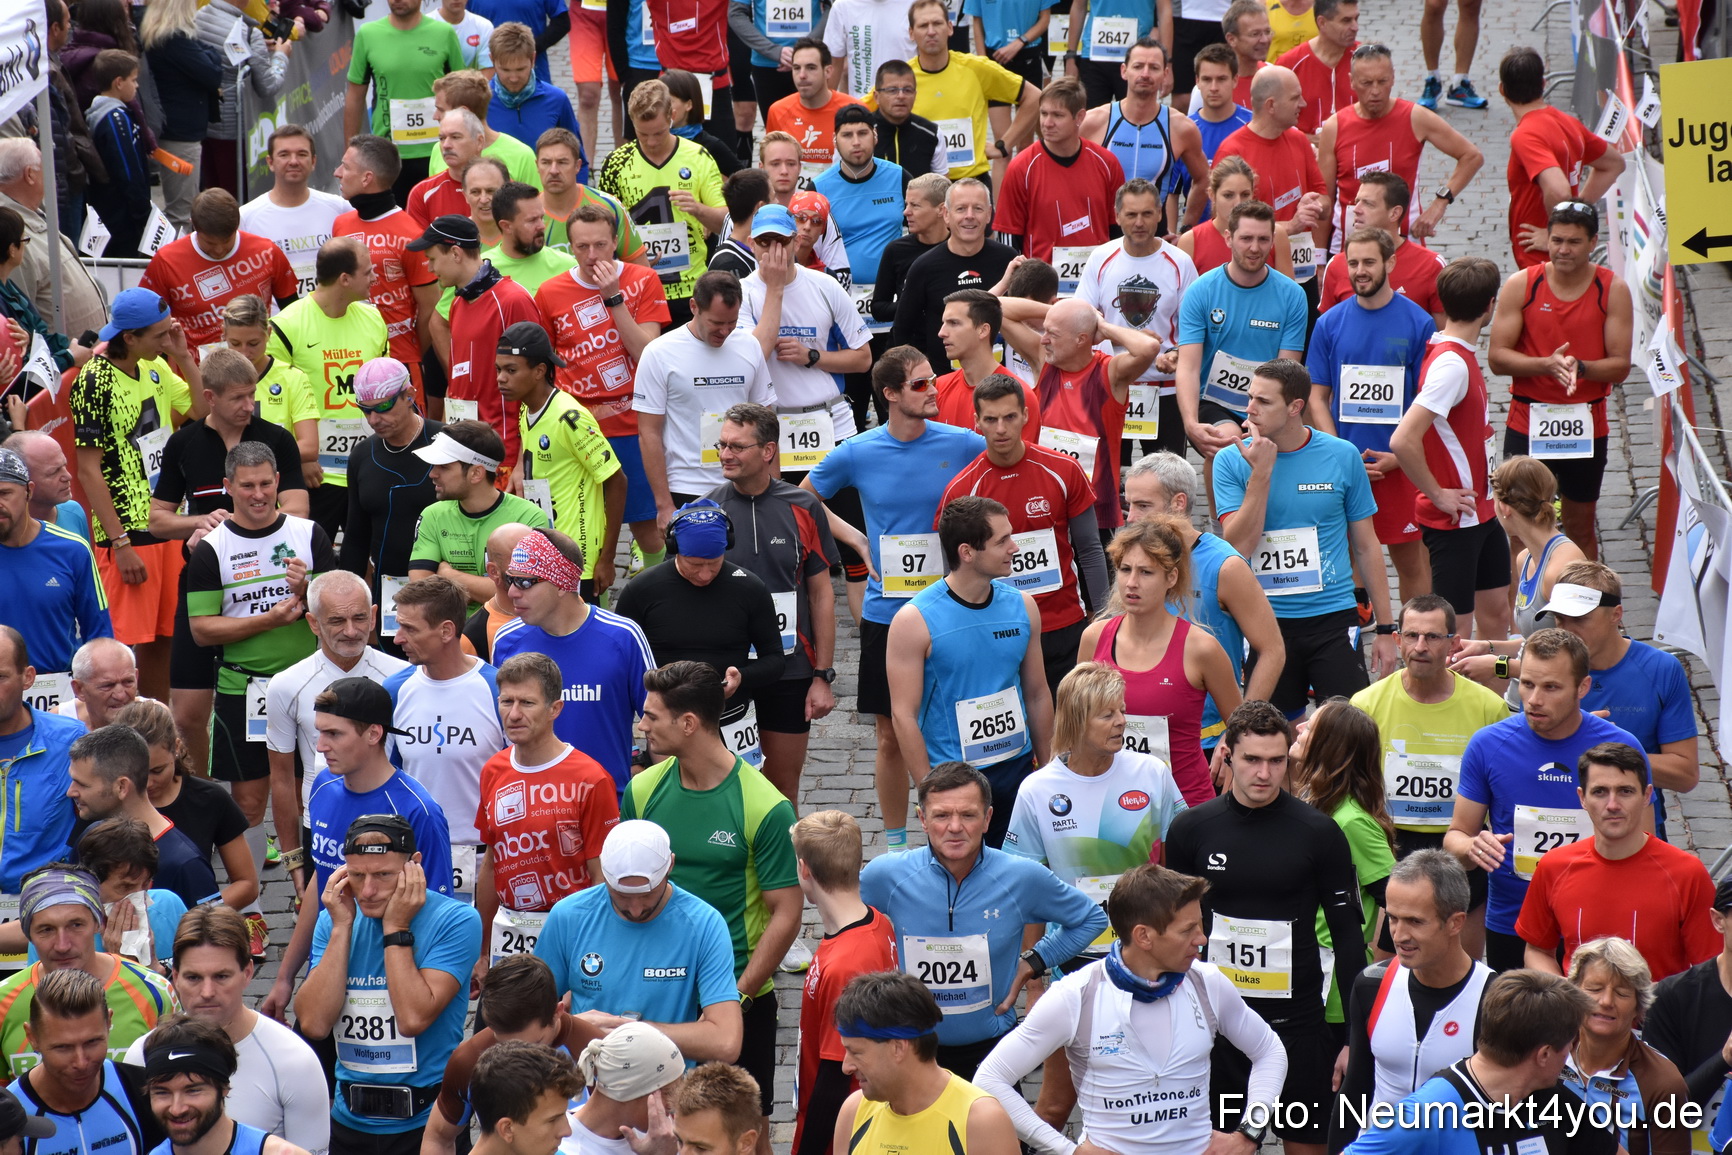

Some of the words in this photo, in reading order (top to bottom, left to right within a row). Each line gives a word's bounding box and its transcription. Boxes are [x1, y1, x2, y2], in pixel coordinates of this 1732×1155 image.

[773, 7, 804, 20] 2164
[1098, 31, 1130, 44] 2647
[406, 113, 425, 127] 55
[1668, 118, 1732, 153] Jug
[801, 153, 834, 161] neumark
[872, 196, 895, 206] THULE
[643, 238, 682, 256] 2673
[296, 277, 319, 295] 75
[957, 277, 983, 286] skinfit
[855, 299, 873, 315] 26
[1250, 318, 1280, 329] BOCK
[322, 348, 362, 362] Müller
[1655, 348, 1666, 373] wn
[1216, 369, 1251, 391] 292
[1349, 382, 1394, 402] 2280
[1358, 406, 1384, 416] Andreas
[1539, 419, 1584, 438] 2098
[787, 431, 821, 449] 149
[1545, 442, 1578, 451] Ferdinand
[149, 450, 165, 472] 26
[793, 454, 817, 463] Markus
[1298, 483, 1333, 491] BOCK
[902, 553, 927, 573] 97
[1011, 549, 1049, 574] 584
[1259, 547, 1309, 572] 2154
[233, 570, 262, 581] OBI
[1013, 575, 1042, 587] Thomas
[1272, 575, 1299, 586] Markus
[904, 578, 927, 588] Martin
[231, 586, 293, 605] Lauftea
[993, 628, 1021, 640] THULE
[968, 710, 1017, 741] 2655
[404, 722, 478, 750] SUSPA
[983, 739, 1012, 755] Matthias
[1414, 761, 1443, 770] BOCK
[1538, 774, 1573, 785] skinfit
[497, 784, 524, 799] raumbox
[1395, 775, 1453, 799] 2058
[1122, 794, 1147, 807] Hervis
[531, 808, 573, 819] schenken
[1405, 804, 1443, 814] Jezussek
[1051, 818, 1078, 829] PARTL
[1546, 816, 1577, 824] BOCK
[1053, 825, 1079, 834] Neumarkt
[708, 830, 737, 845] AOK
[1005, 831, 1019, 842] CK
[1207, 864, 1226, 872] Sondico
[1237, 927, 1267, 937] BOCK
[934, 944, 963, 952] BOCK
[1227, 942, 1267, 968] 151
[643, 967, 687, 979] BOCK
[917, 959, 978, 986] 2024
[1235, 973, 1261, 985] Lukas
[356, 997, 387, 1006] BOCK
[932, 991, 967, 1002] Michael
[341, 1014, 397, 1041] 2381
[353, 1047, 392, 1061] Wolfgang
[1103, 1085, 1202, 1111] IronTrizone.de
[1130, 1105, 1189, 1127] ULMER
